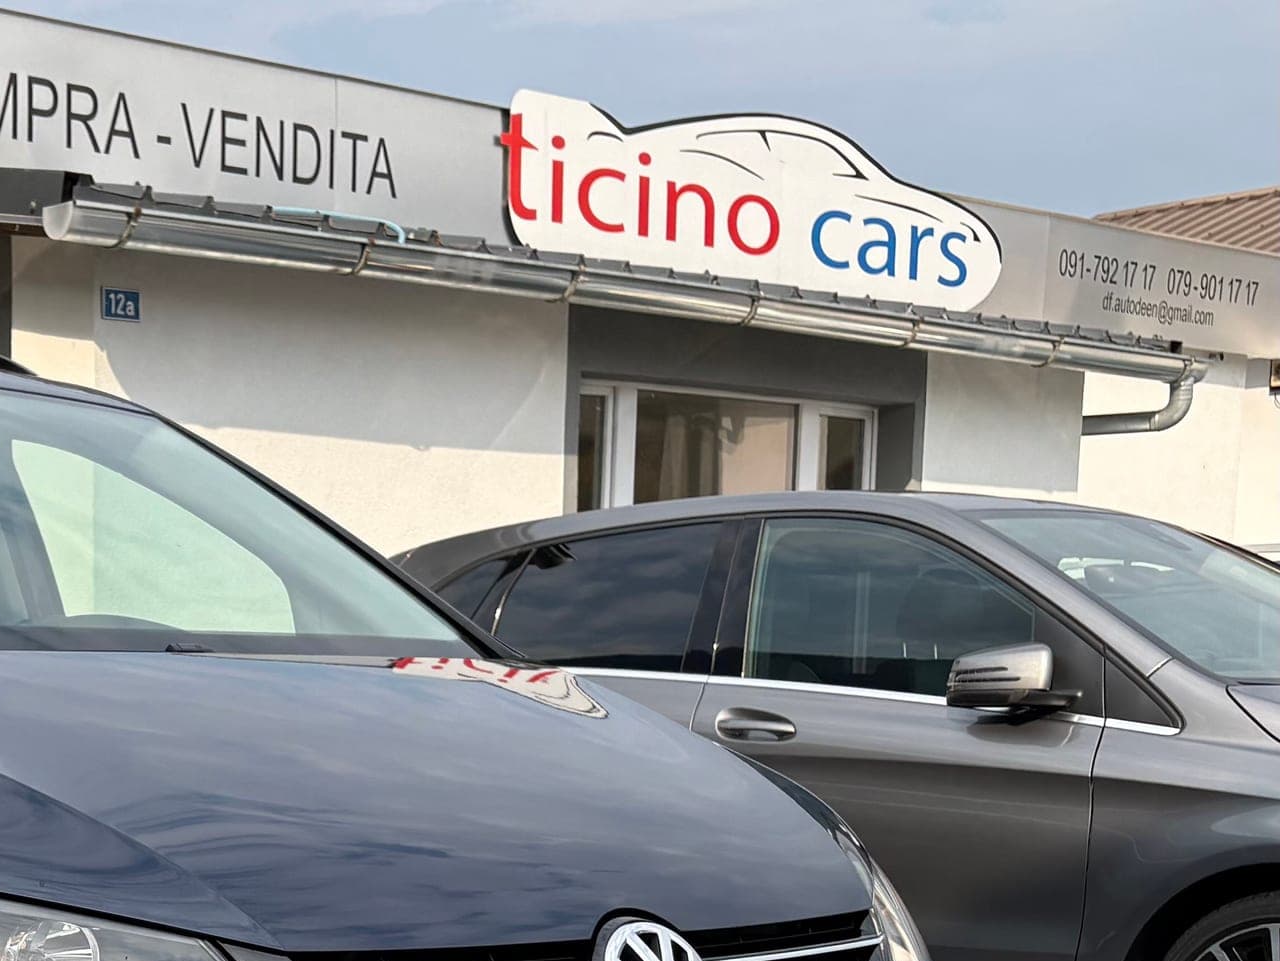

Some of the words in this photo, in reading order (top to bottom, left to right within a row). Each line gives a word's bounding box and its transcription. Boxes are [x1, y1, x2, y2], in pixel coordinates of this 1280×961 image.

[500, 113, 780, 256] ticino
[811, 209, 968, 288] cars
[1059, 248, 1119, 285] 091-792
[108, 293, 135, 316] 12a
[1102, 291, 1214, 326] df.autodeen@gmail.com
